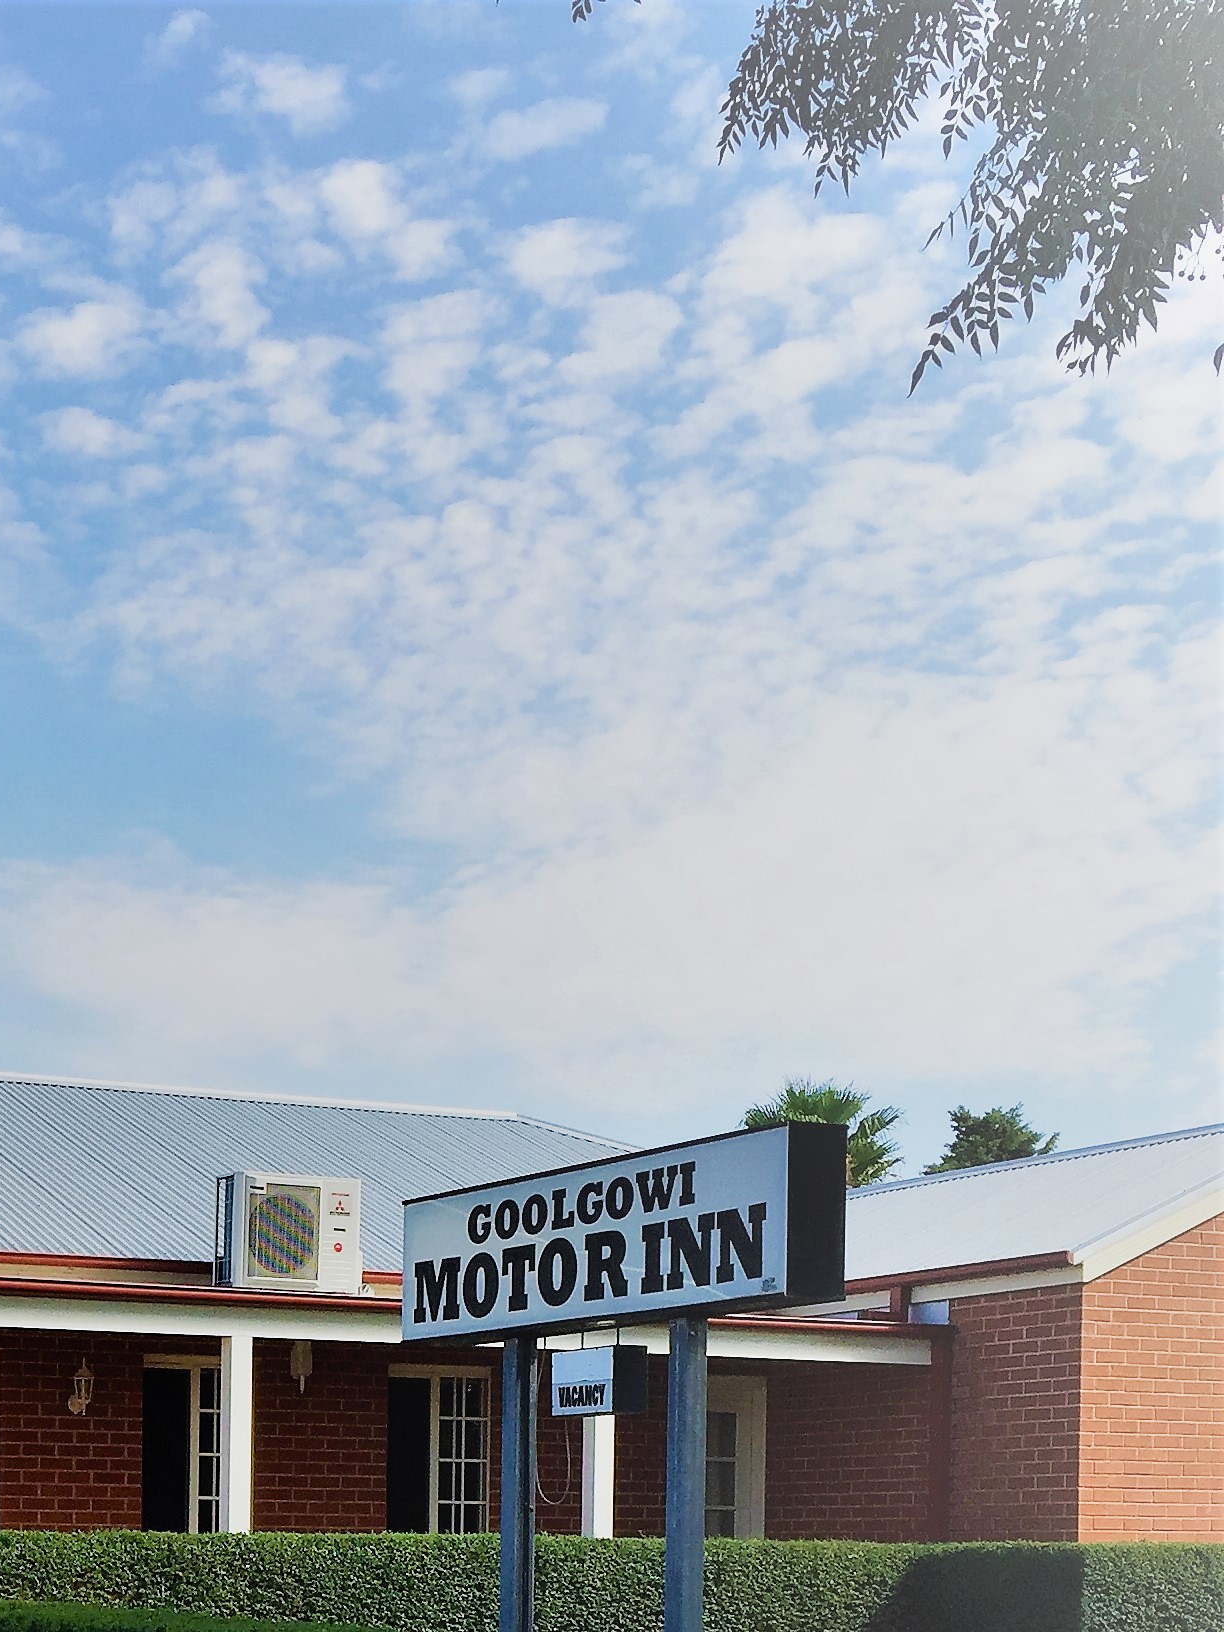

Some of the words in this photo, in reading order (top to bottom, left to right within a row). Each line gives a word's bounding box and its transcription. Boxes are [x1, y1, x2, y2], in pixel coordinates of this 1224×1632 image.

[468, 1161, 696, 1244] GOOLGOWI
[413, 1231, 628, 1324] MOTOR
[640, 1202, 767, 1294] INN
[558, 1383, 606, 1408] VACANCY
